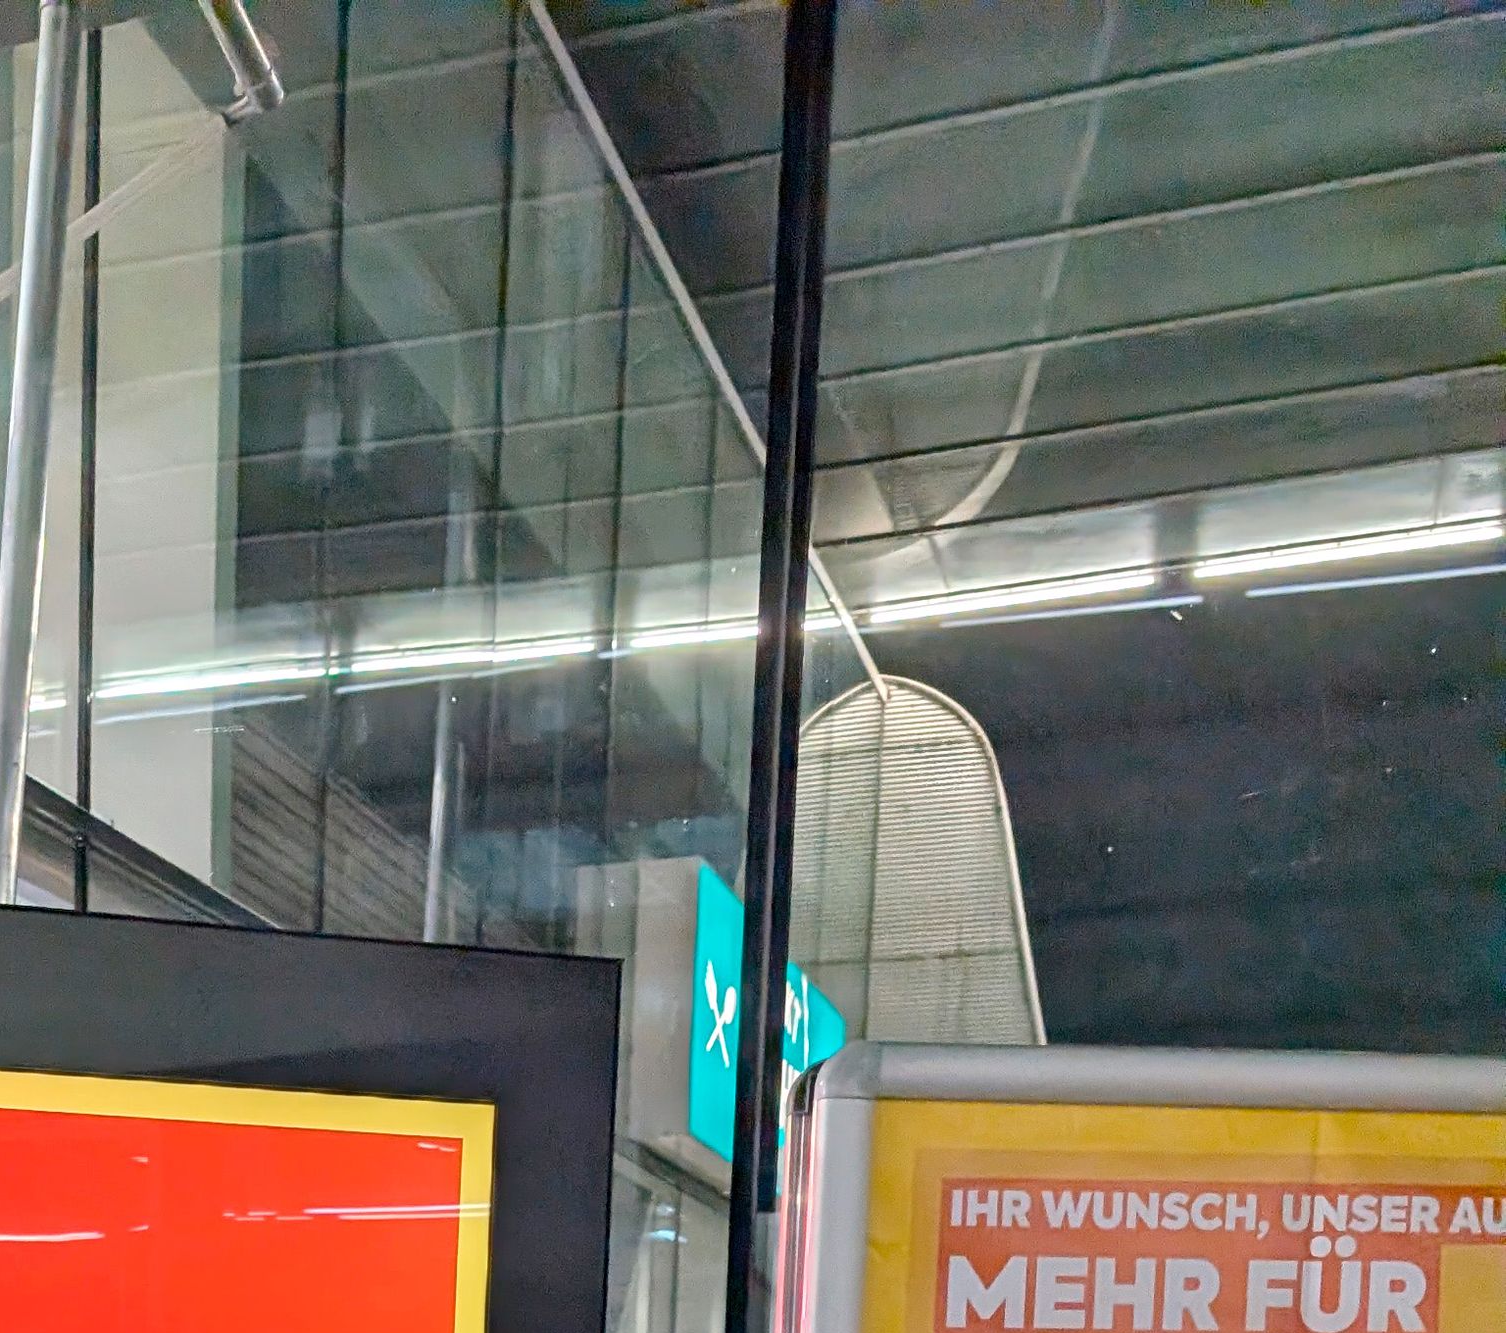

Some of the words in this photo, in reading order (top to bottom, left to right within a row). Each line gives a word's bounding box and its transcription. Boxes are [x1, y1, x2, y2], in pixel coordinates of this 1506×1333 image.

[950, 1188, 1033, 1228] IHR
[1042, 1190, 1270, 1241] WUNSCH,
[1282, 1194, 1440, 1234] UNSER
[1448, 1196, 1506, 1235] AU
[944, 1255, 1221, 1332] MEHR
[1245, 1235, 1427, 1333] FÜR
